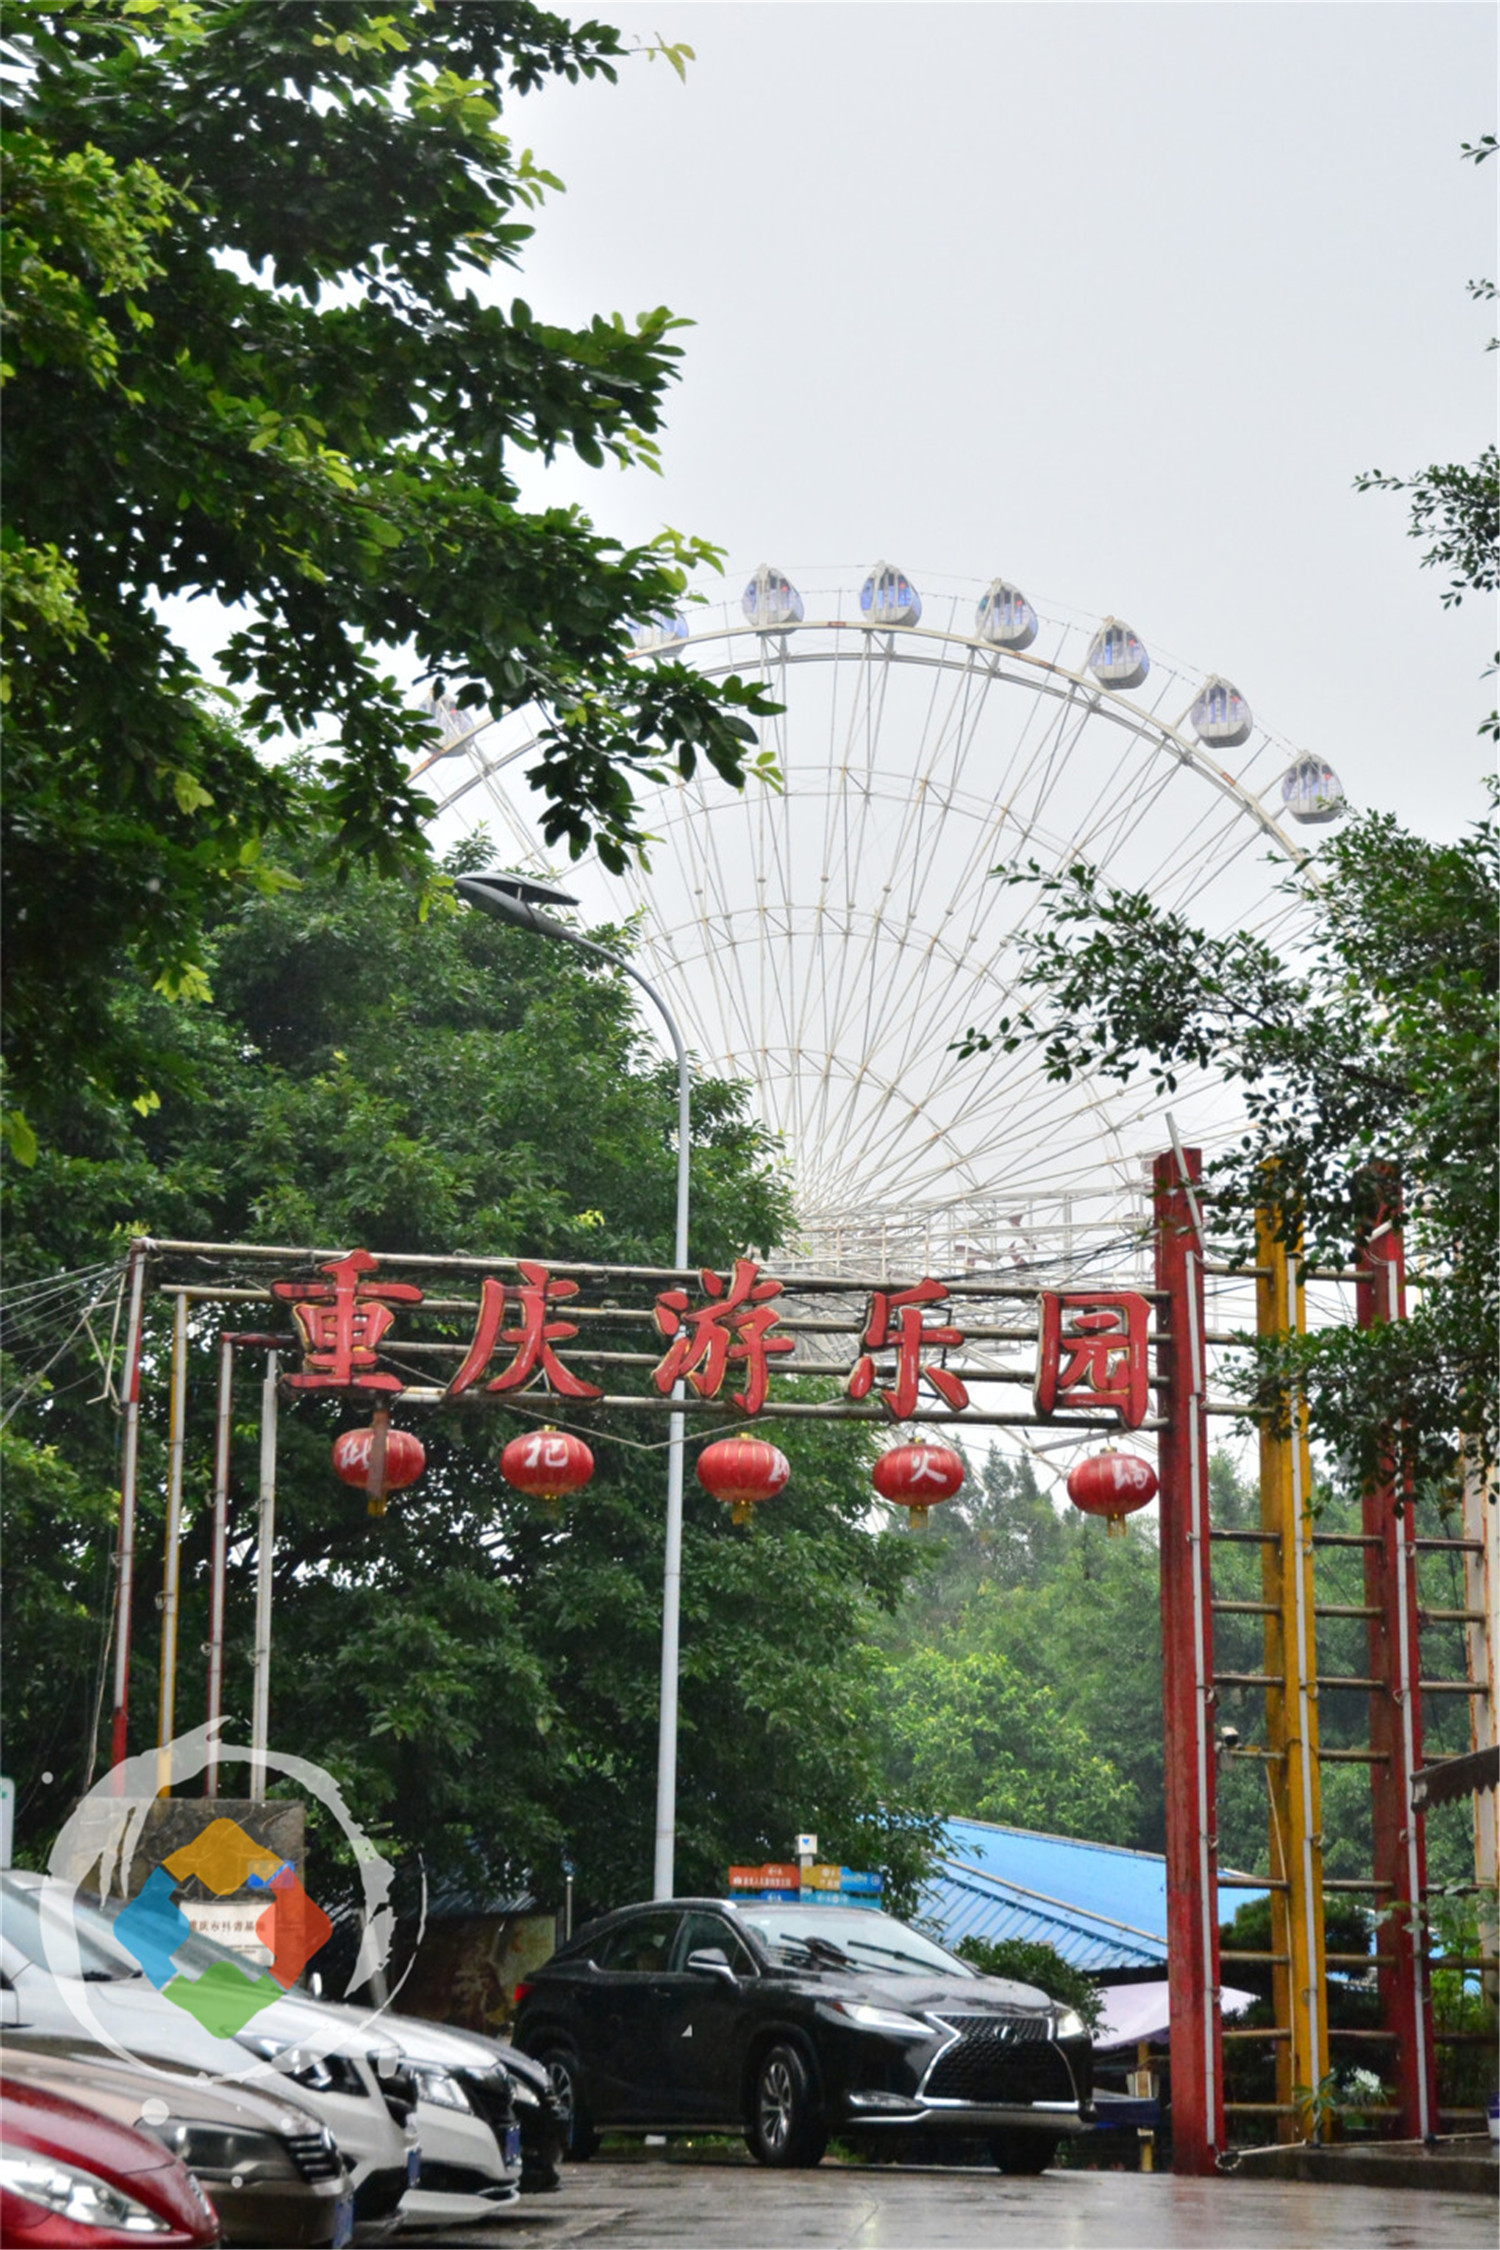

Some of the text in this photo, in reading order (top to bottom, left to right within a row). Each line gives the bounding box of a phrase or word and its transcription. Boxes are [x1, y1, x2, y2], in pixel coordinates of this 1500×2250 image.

[270, 1248, 1152, 1429] 重庆游乐园
[910, 1449, 947, 1483] 火
